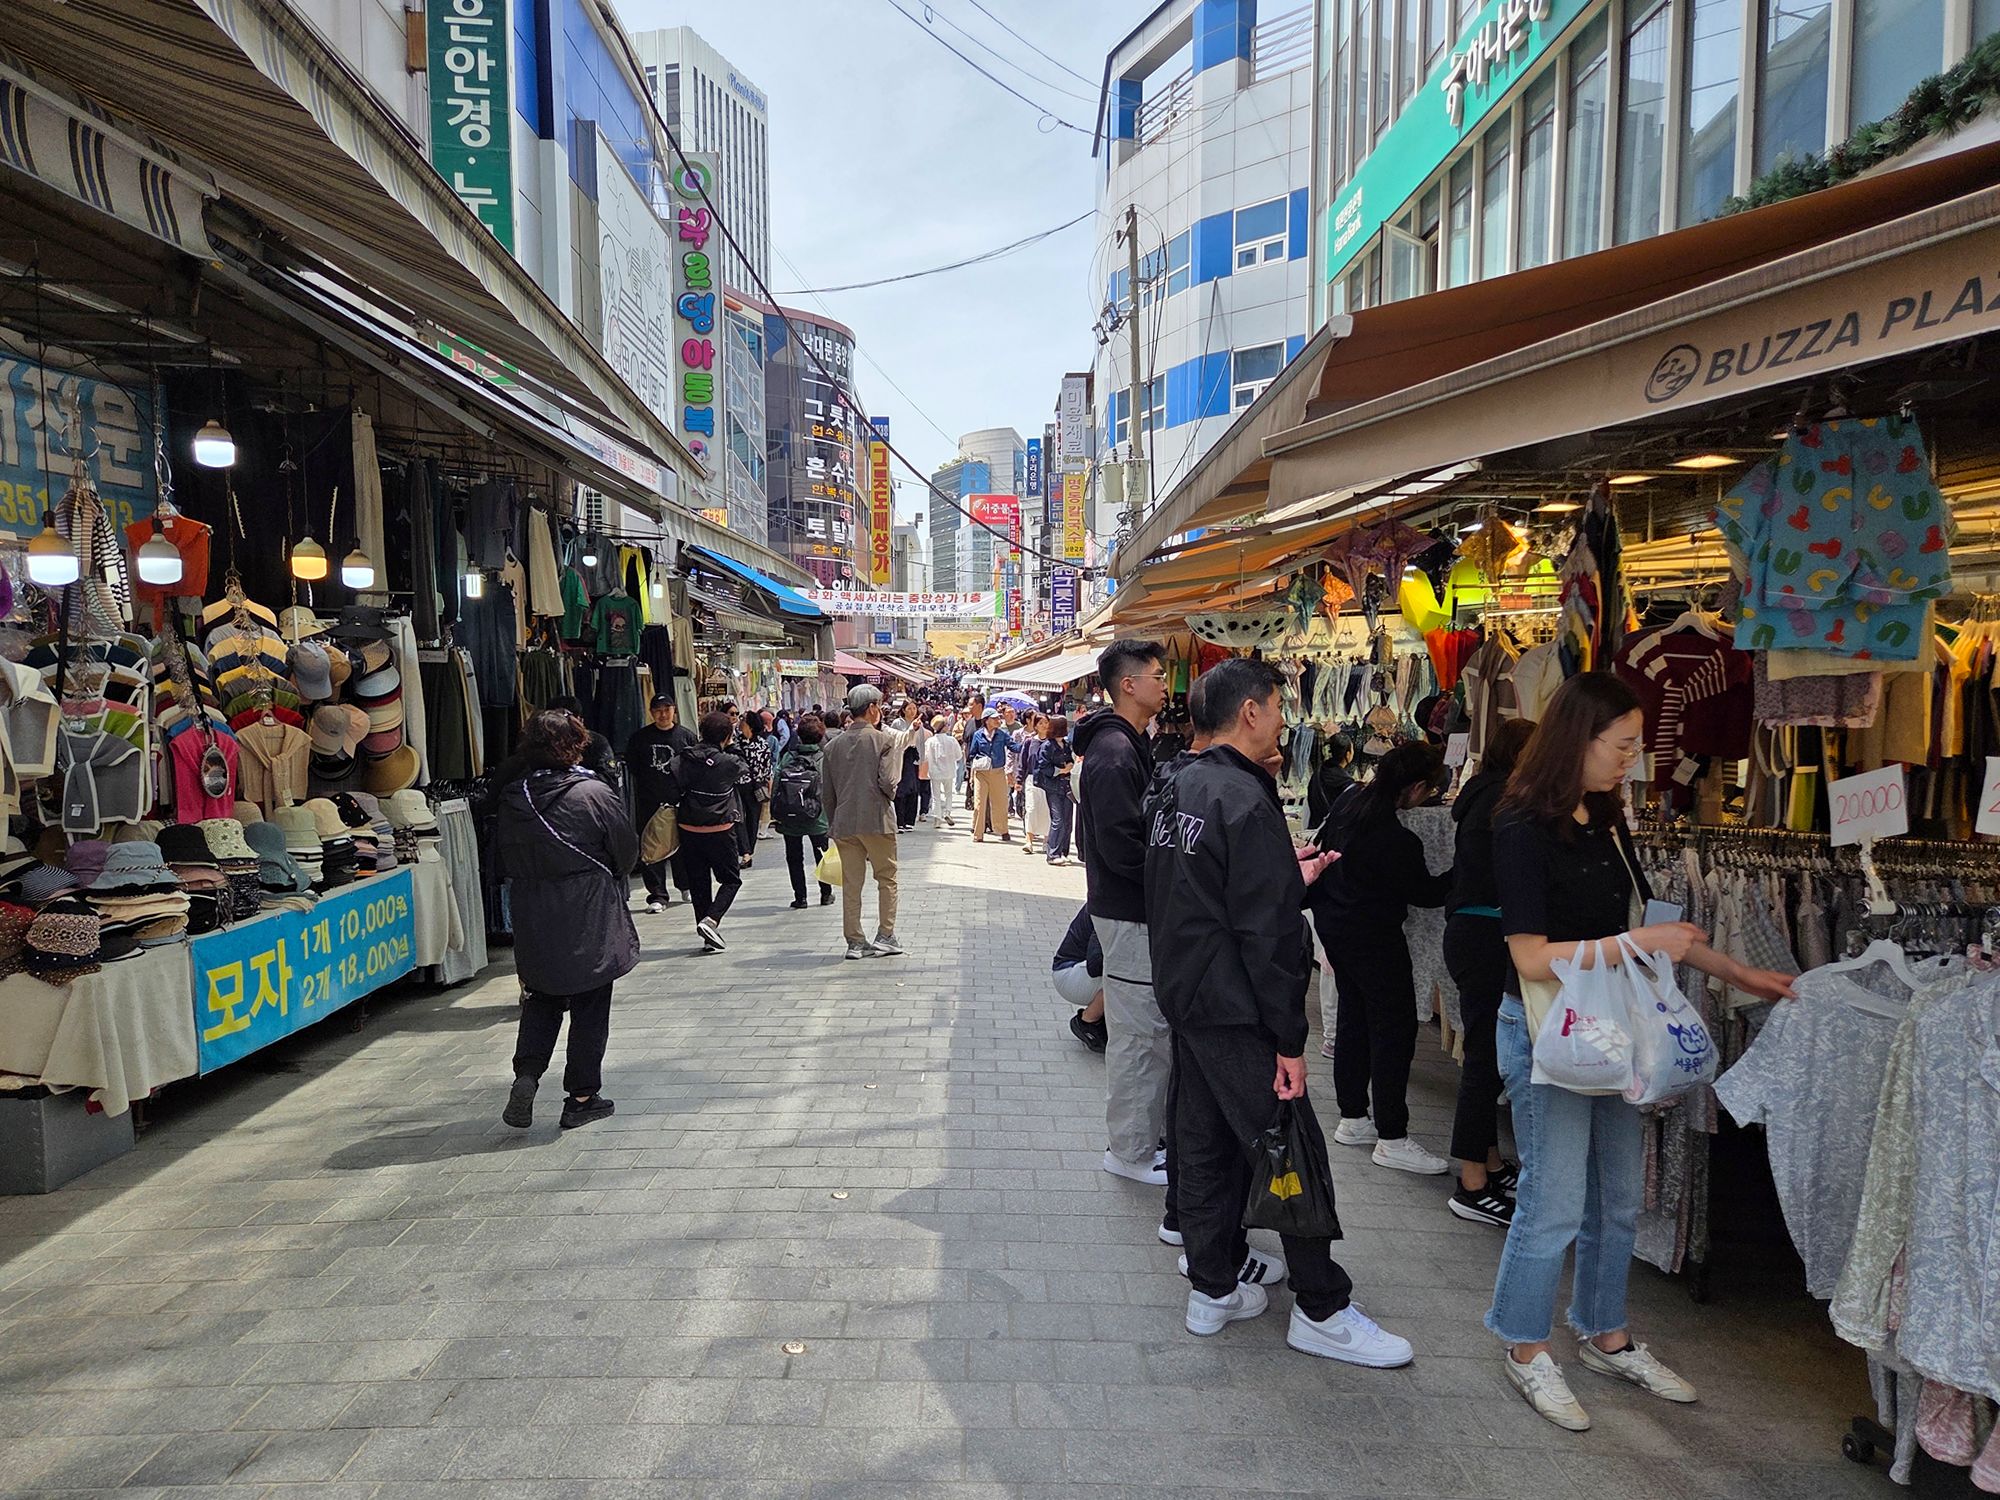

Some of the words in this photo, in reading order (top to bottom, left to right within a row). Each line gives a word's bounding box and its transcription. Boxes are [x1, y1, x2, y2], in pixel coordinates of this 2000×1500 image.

[1703, 312, 1861, 386] BUZZA
[1029, 454, 1039, 491] 우리은행
[873, 447, 889, 573] 그릇도매상가
[982, 502, 1010, 515] 서중물
[1067, 479, 1082, 544] 명동칼국수
[876, 603, 905, 612] 선착순
[908, 593, 960, 604] 중앙상가
[962, 592, 982, 604] 1층
[300, 918, 331, 960] 1개
[338, 894, 409, 945] 10,000원
[203, 938, 294, 1044] 모자
[302, 963, 331, 1009] 2개
[338, 933, 410, 990] 18,000원
